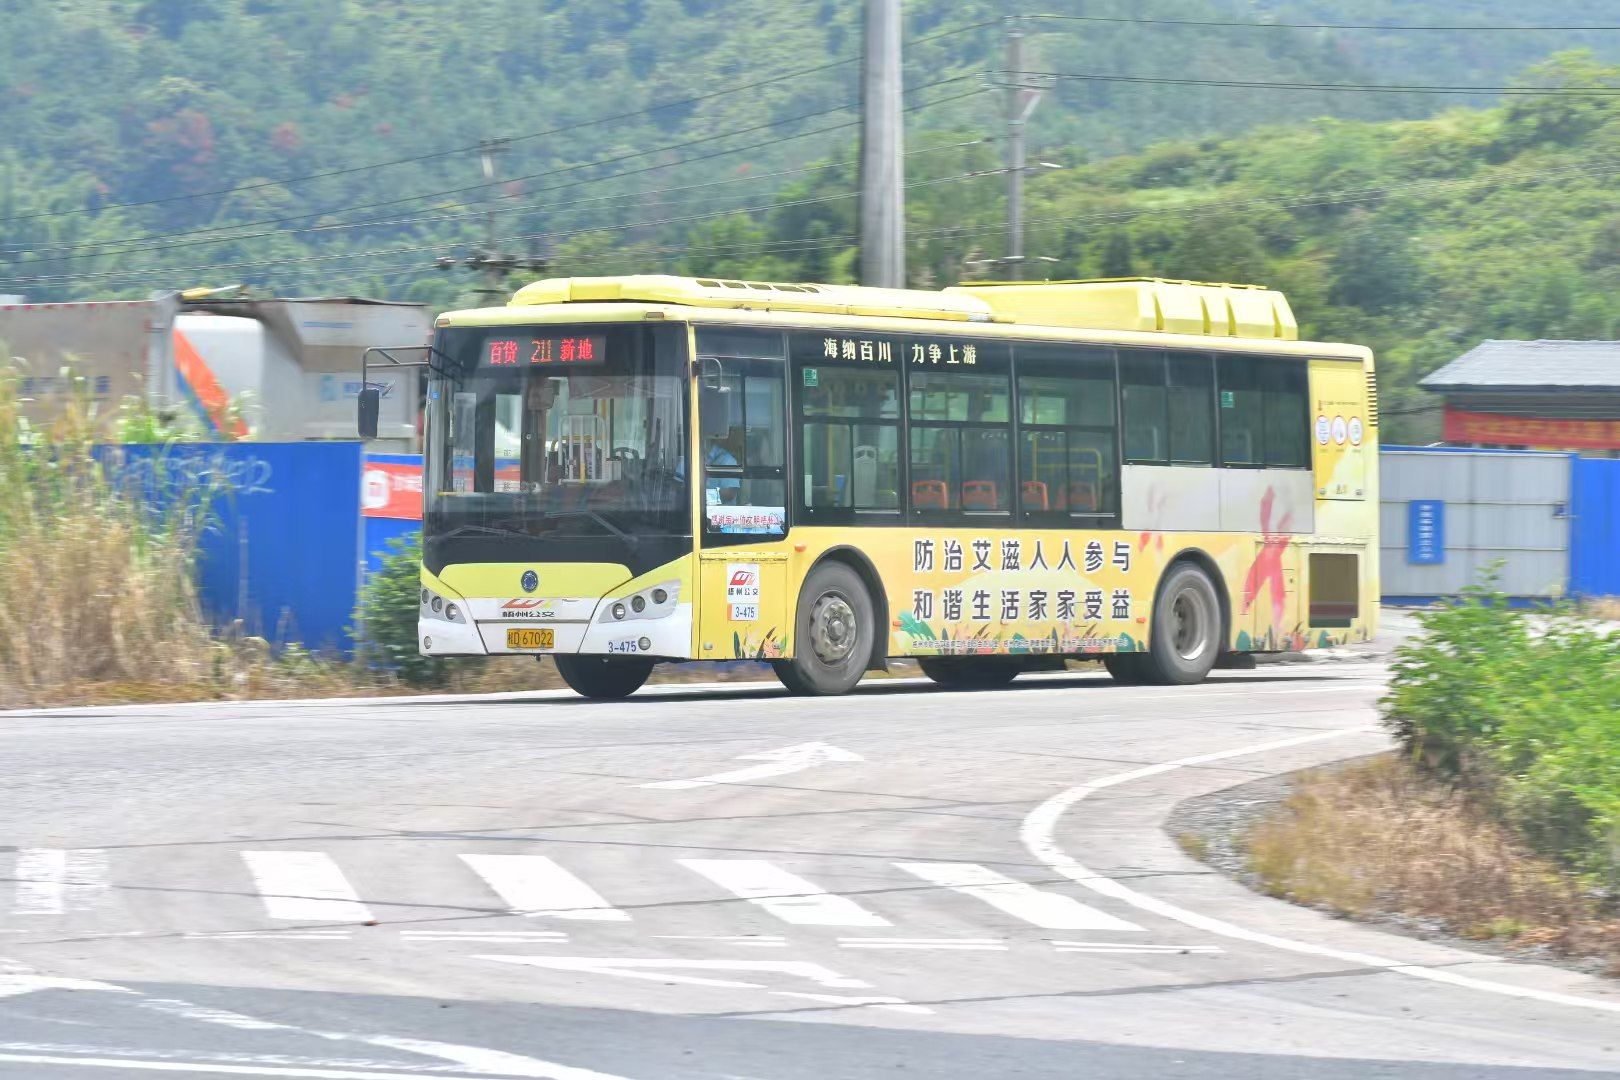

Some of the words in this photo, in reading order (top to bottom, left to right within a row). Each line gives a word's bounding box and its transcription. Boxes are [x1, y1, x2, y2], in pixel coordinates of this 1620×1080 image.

[489, 340, 518, 364] 百货
[531, 339, 552, 362] 211
[560, 338, 593, 361] 新地
[824, 338, 892, 363] 海纳百川
[911, 344, 977, 365] 力争上游
[914, 540, 1130, 572] 防治艾滋人人参与
[735, 606, 755, 618] 3-475
[913, 589, 1130, 621] 和谐生活家家受益
[608, 641, 637, 653] 3-475
